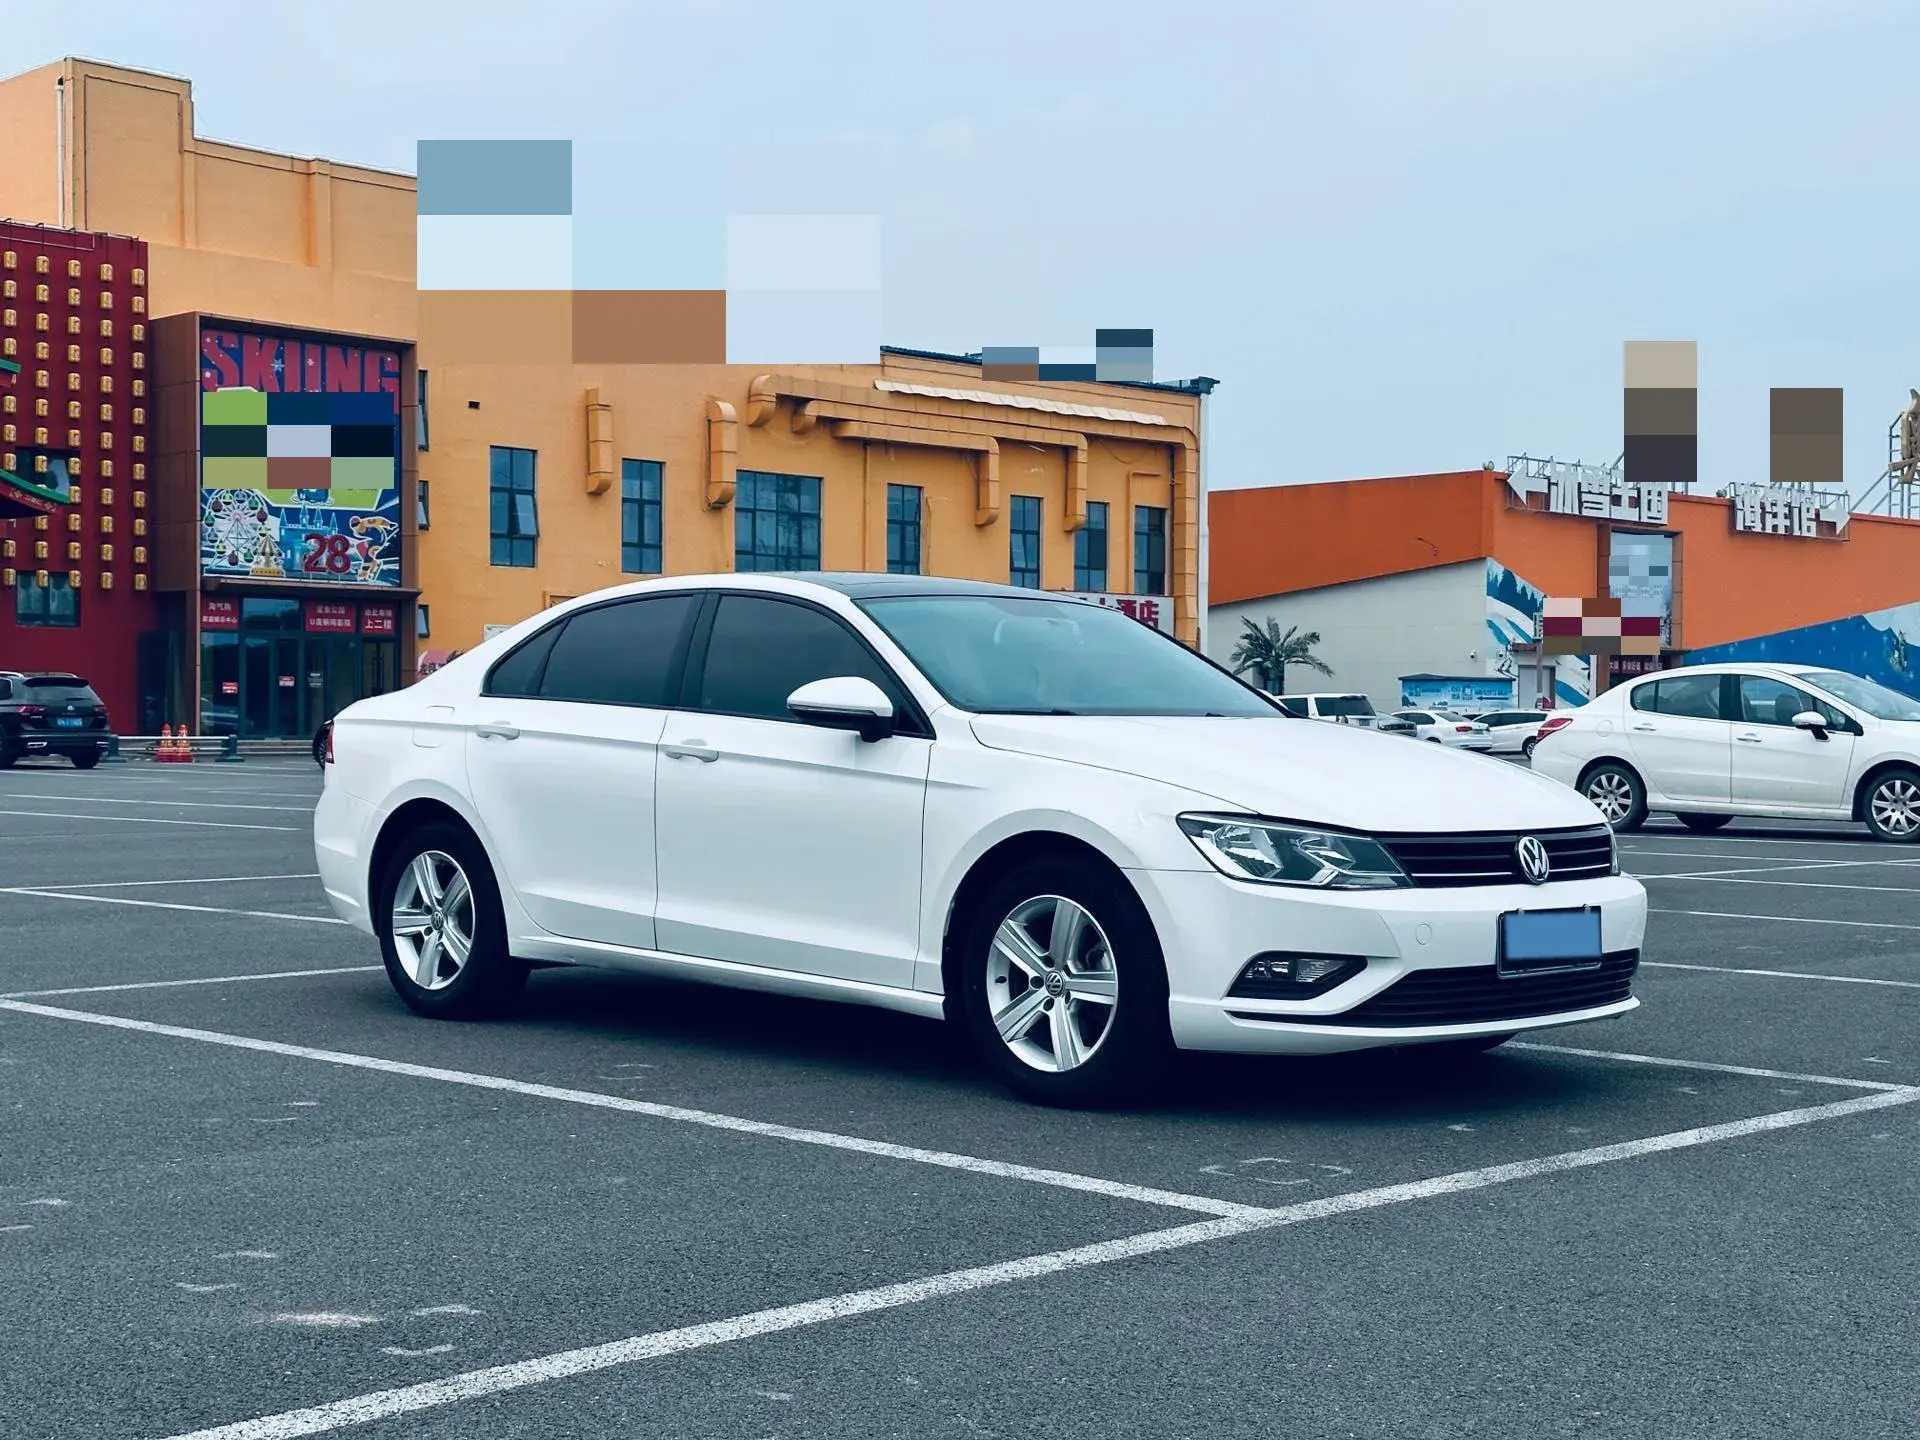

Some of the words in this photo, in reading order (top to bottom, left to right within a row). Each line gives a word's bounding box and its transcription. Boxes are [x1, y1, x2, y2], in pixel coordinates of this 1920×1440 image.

[202, 330, 400, 414] SKIING
[304, 533, 351, 574] 28
[365, 619, 392, 629] 上二楼
